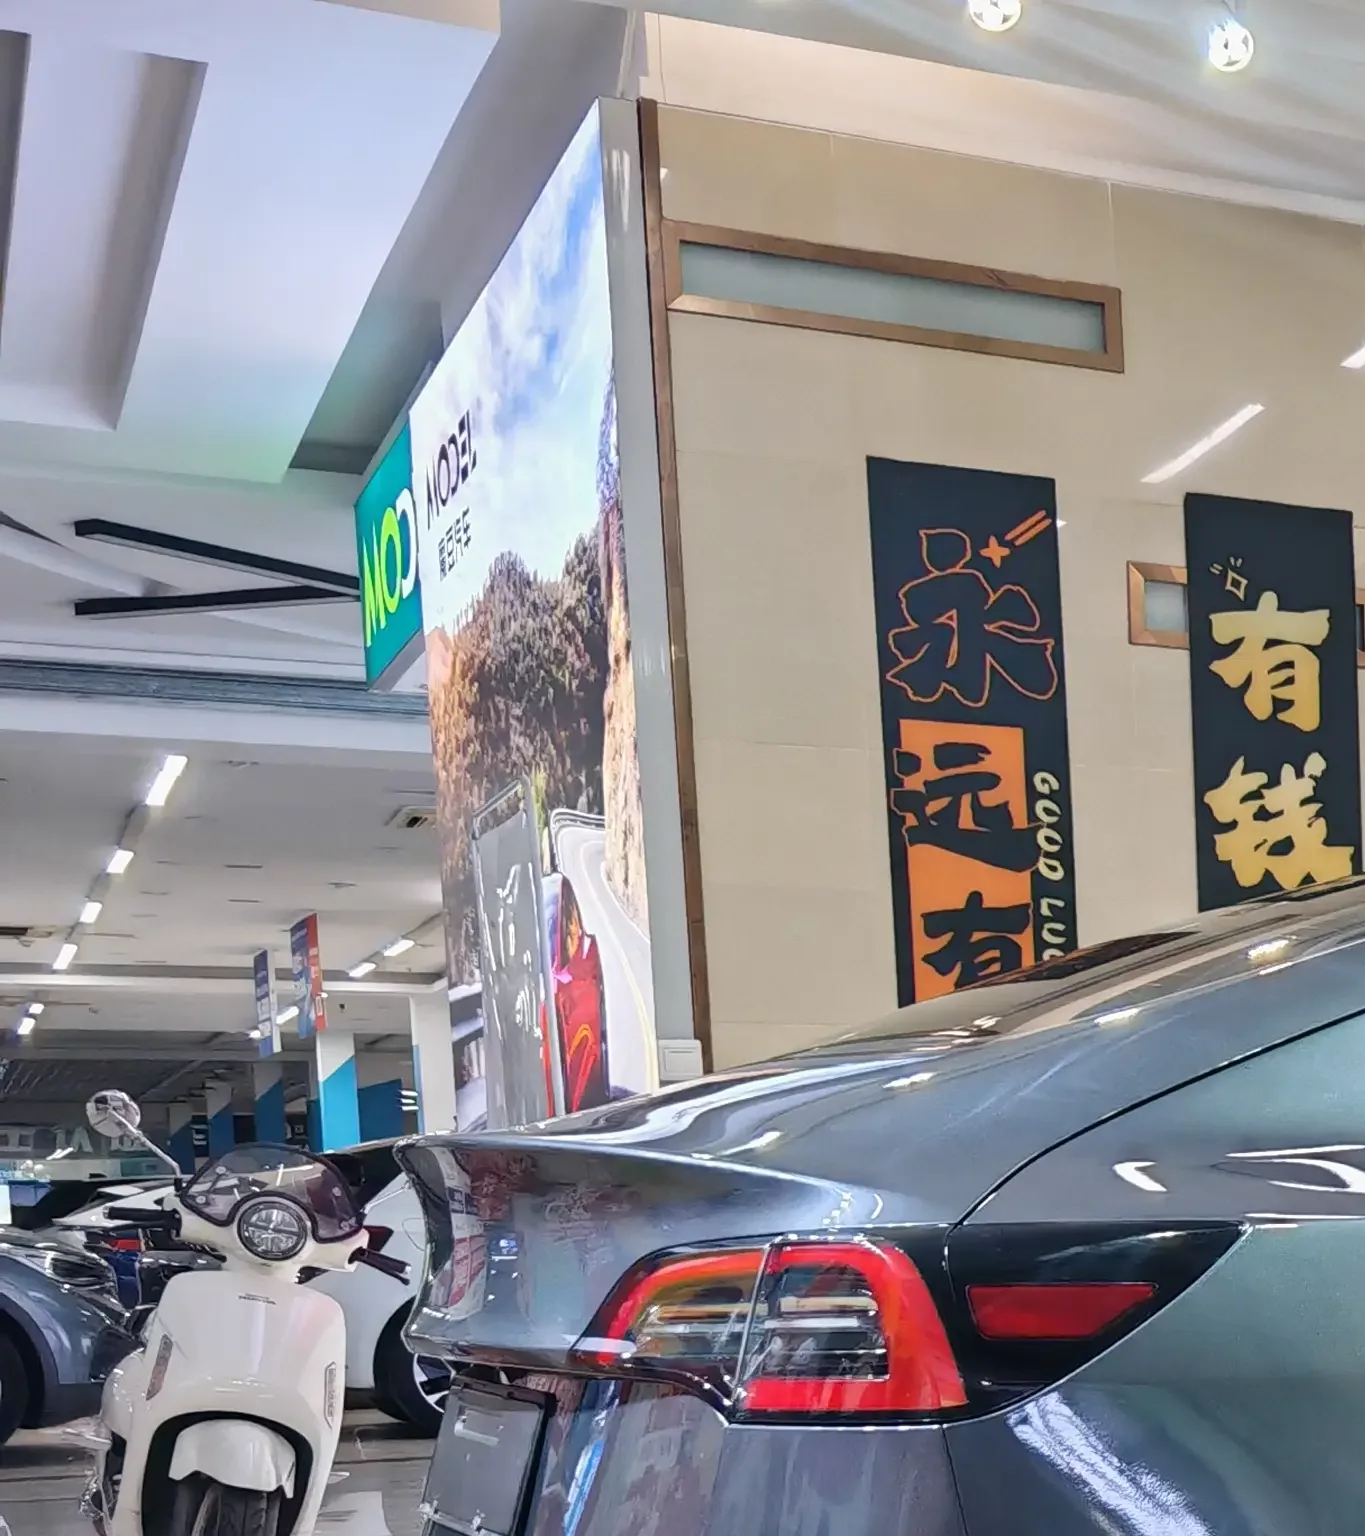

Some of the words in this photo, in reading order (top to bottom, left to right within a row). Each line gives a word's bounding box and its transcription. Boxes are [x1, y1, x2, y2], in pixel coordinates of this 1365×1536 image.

[426, 410, 477, 530] MODEL
[1204, 591, 1355, 890] 有钱
[1033, 771, 1065, 881] GOOD
